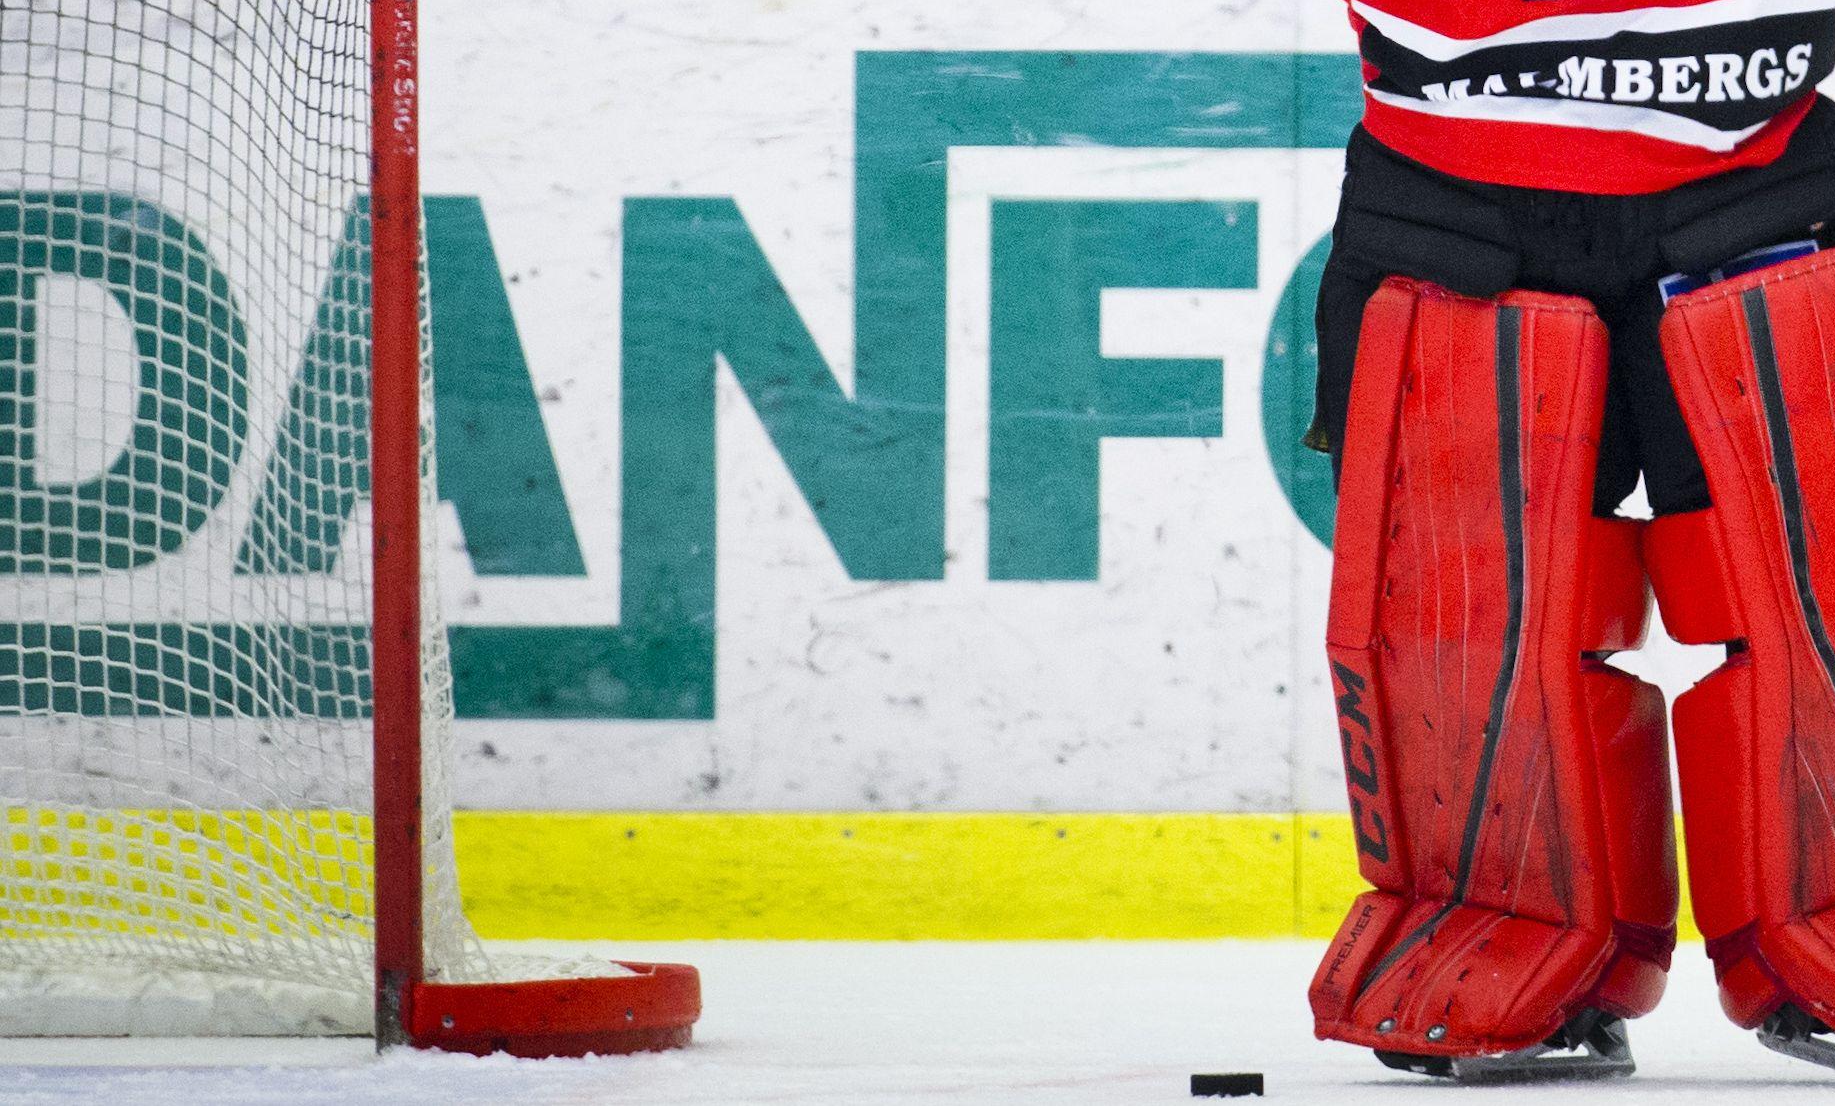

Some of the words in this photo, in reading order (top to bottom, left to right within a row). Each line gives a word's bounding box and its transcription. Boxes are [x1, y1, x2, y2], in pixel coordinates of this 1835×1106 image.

[0, 50, 1362, 720] DANF
[1332, 660, 1389, 866] CCM
[1322, 903, 1378, 986] PREMIER
